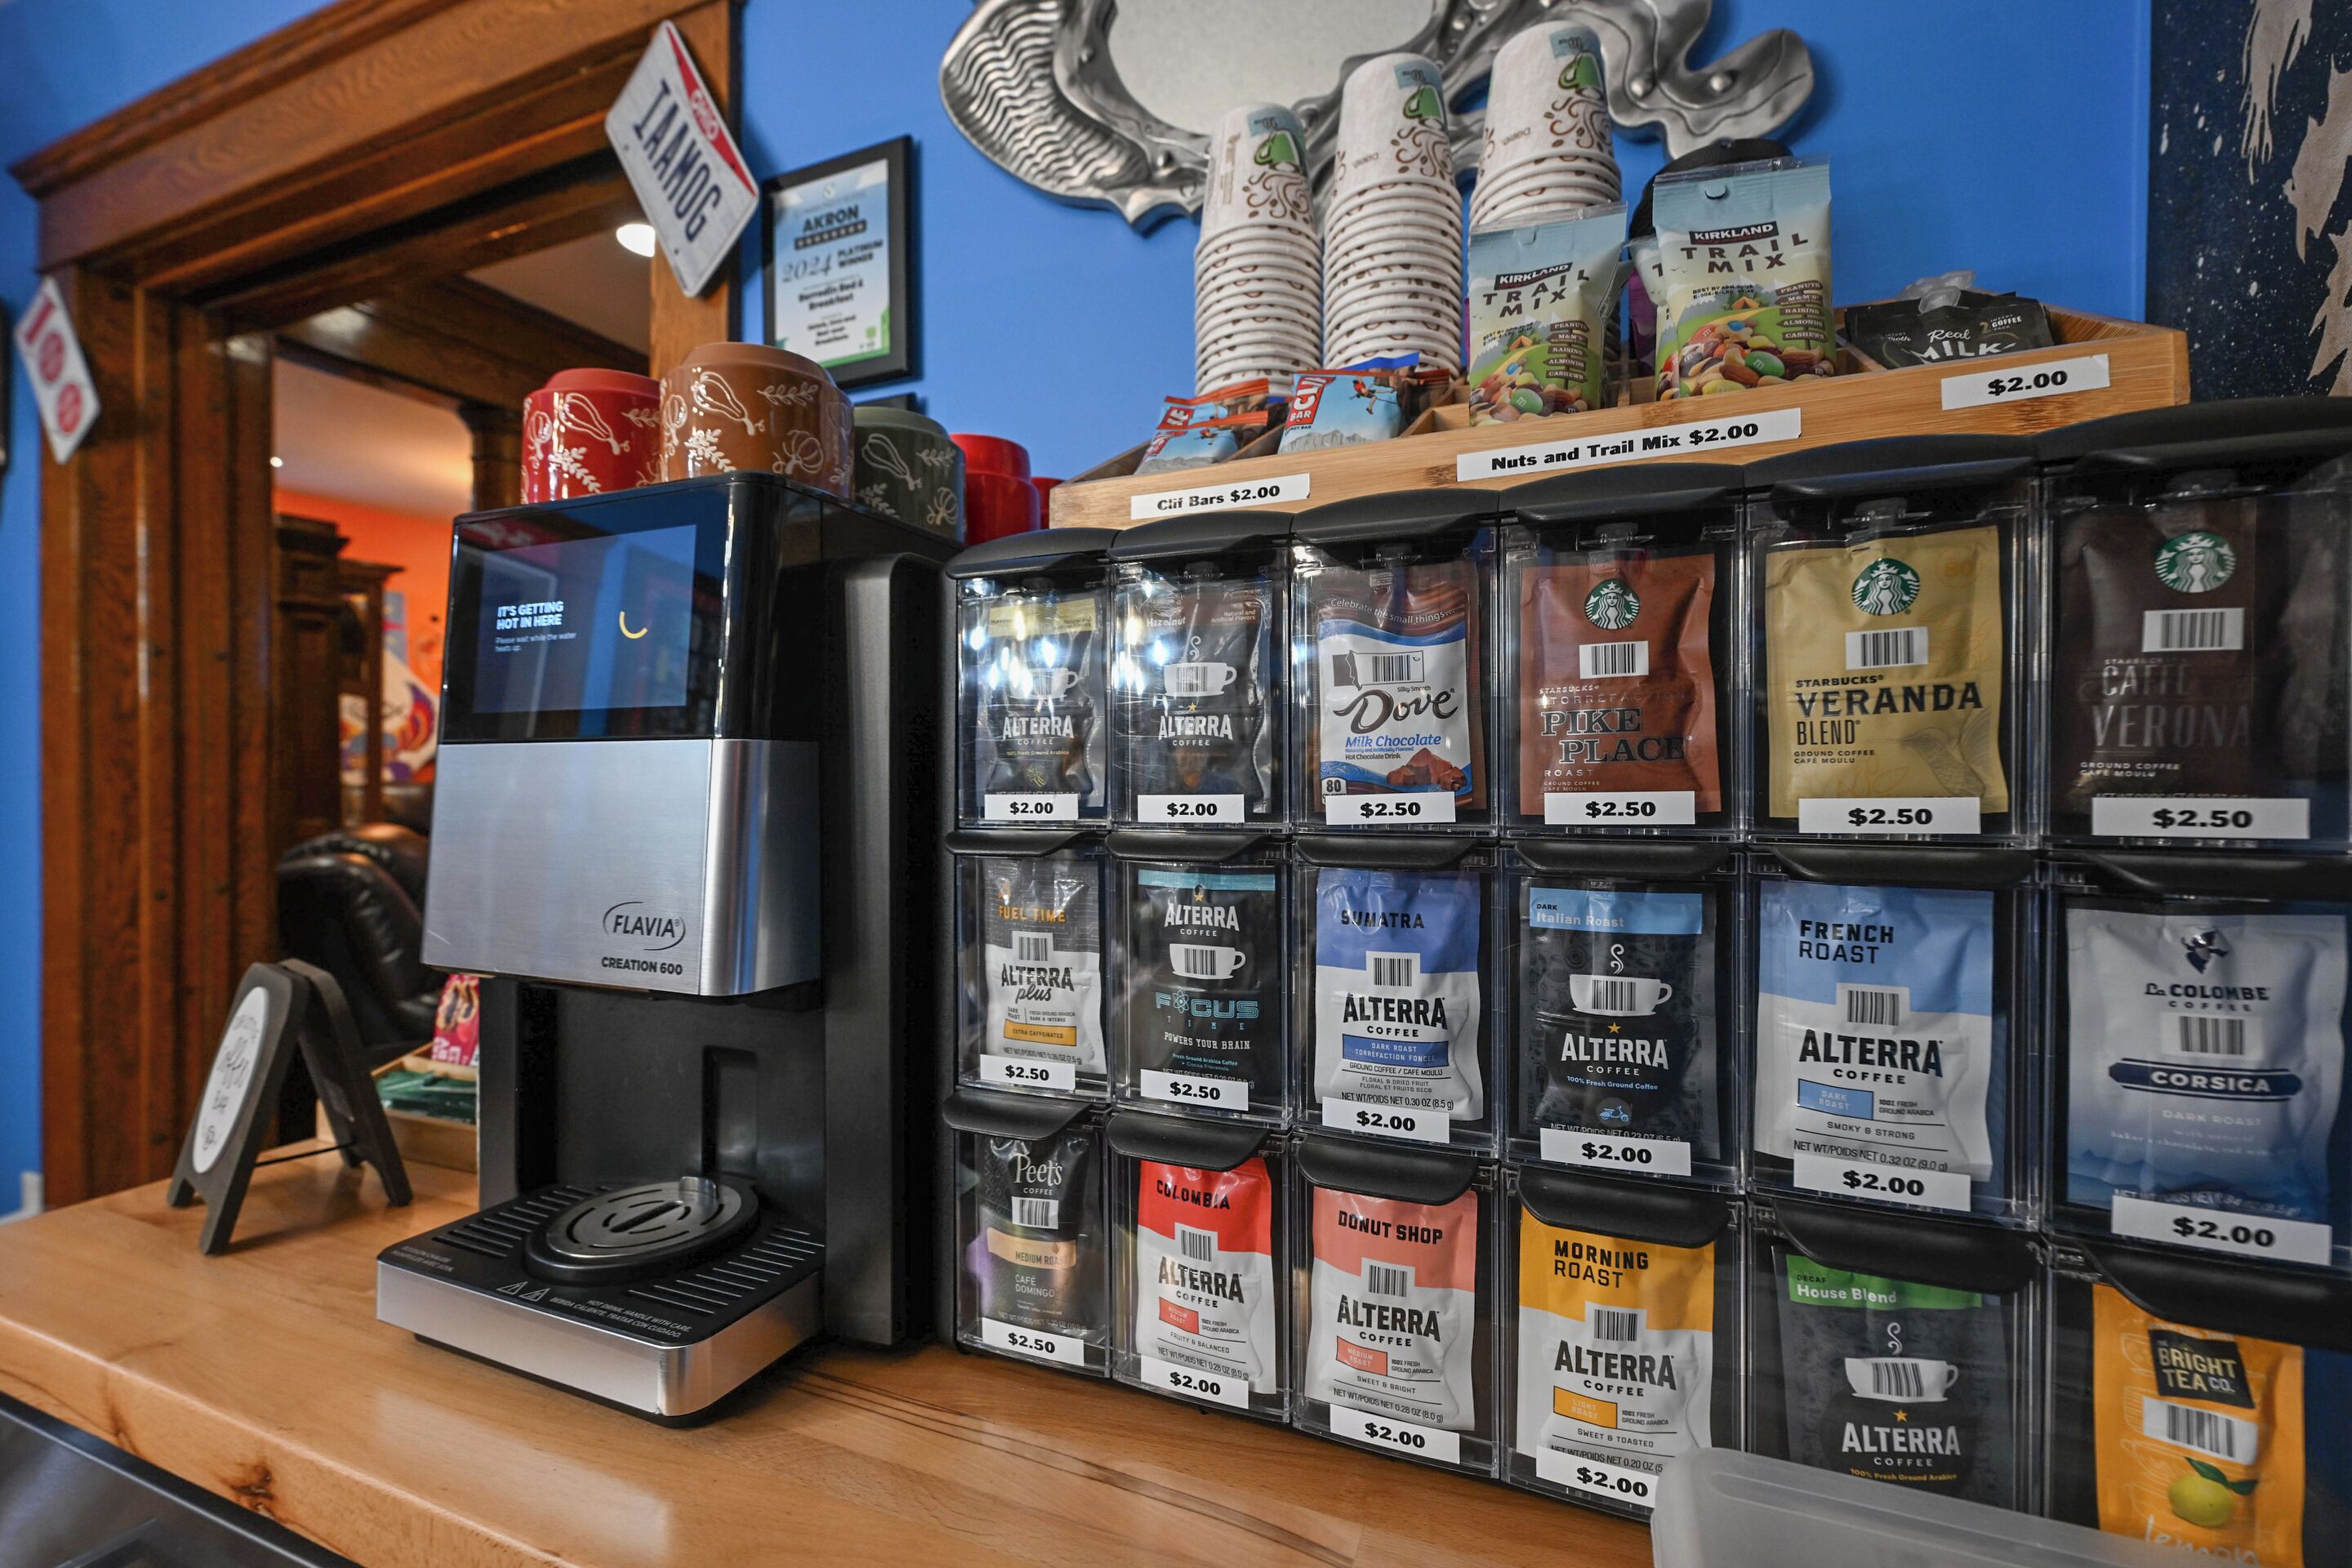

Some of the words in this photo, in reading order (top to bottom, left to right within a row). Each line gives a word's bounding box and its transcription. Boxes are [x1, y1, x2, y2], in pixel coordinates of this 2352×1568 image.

[804, 204, 858, 233] AKRON
[1695, 224, 1775, 241] KIRKLAND
[1681, 234, 1808, 260] TRAIL
[782, 254, 831, 283] 2024
[1708, 253, 1786, 273] MIX
[1499, 264, 1569, 284] KIRKLAND
[1483, 270, 1590, 305] TRAIL
[1781, 283, 1820, 293] PEANUTS
[1500, 288, 1567, 318] MIX
[1991, 315, 2022, 327] COFFEE
[1927, 329, 1971, 343] Real
[1548, 371, 1583, 380] CASHEWS
[1988, 370, 2068, 396] $2.00
[1290, 410, 1312, 421] BAR
[1491, 455, 1537, 470] Nuts
[1544, 447, 1579, 464] and
[1588, 439, 1634, 458] Trail
[1642, 434, 1681, 451] Mix
[1689, 423, 1758, 445] $2.00
[1157, 497, 1183, 511] Clif
[1189, 493, 1225, 507] Bars
[1230, 484, 1281, 502] $2.00
[497, 606, 516, 617] IT'S
[518, 601, 564, 616] GETTING
[1330, 599, 1373, 612] Celebrate
[1374, 608, 1388, 618] the
[1390, 613, 1413, 623] small
[497, 618, 519, 630] HOT
[520, 617, 532, 628] IN
[533, 613, 562, 626] HERE
[1147, 616, 1186, 627] Hazelnut
[1333, 688, 1459, 734] Dove
[1795, 682, 1983, 719] VERANDA
[1003, 715, 1074, 740] ALTERRA
[1158, 714, 1233, 741] ALTERRA
[1541, 706, 1642, 736] PIKE
[2092, 704, 2251, 748] VERONA
[1346, 737, 1374, 747] Milk
[1376, 733, 1441, 747] Chocolate
[1559, 736, 1686, 764] PLACE
[1326, 779, 1341, 793] 80
[1009, 801, 1054, 815] $2.00
[1166, 802, 1218, 817] $2.00
[1360, 802, 1421, 817] $2.50
[1586, 800, 1656, 818] $2.50
[1848, 808, 1933, 826] $2.50
[2152, 808, 2253, 829] $2.50
[999, 906, 1027, 920] FUEL
[1032, 908, 1066, 923] TIME
[1165, 902, 1240, 931] ALTERRA
[1341, 909, 1425, 929] SUMATRA
[1536, 912, 1581, 925] Italian
[1586, 915, 1624, 928] Roast
[613, 915, 675, 938] FLAVIA
[1180, 929, 1217, 937] COFFEE
[1800, 920, 1895, 943] FRENCH
[1799, 941, 1879, 964] ROAST
[602, 956, 657, 973] CREATION
[660, 962, 683, 975] 600
[1001, 963, 1075, 992] ALTERRA
[1015, 982, 1052, 1004] plus
[2145, 982, 2166, 996] La
[2171, 983, 2270, 1001] COLOMBE
[1343, 993, 1448, 1030] ALTERRA
[1029, 1030, 1063, 1039] CAFFEINATED
[1164, 1031, 1193, 1046] POWERS
[1196, 1038, 1218, 1049] YOUR
[1222, 1040, 1250, 1049] BRAIN
[1366, 1026, 1419, 1037] COFFEE
[1371, 1042, 1390, 1050] DARK
[1393, 1044, 1417, 1053] ROAST
[1561, 1032, 1669, 1070] ALTERRA
[1799, 1029, 1944, 1078] ALTERRA
[1005, 1065, 1049, 1081] $2.50
[1350, 1062, 1373, 1071] GROUND
[1374, 1065, 1396, 1074] COFFEE
[1587, 1065, 1640, 1076] COFFEE
[1833, 1068, 1906, 1085] COFFEE
[1169, 1081, 1221, 1100] $2.50
[2151, 1071, 2271, 1094] CORSICA
[1356, 1110, 1415, 1131] $2.00
[1827, 1121, 1861, 1134] SMOKY
[1876, 1128, 1915, 1140] STRONG
[1581, 1142, 1652, 1164] $2.00
[1014, 1153, 1062, 1186] Peet's
[1023, 1187, 1053, 1196] COFFEE
[1842, 1169, 1924, 1196] $2.00
[1156, 1179, 1231, 1210] COLOMBIA
[1338, 1210, 1392, 1237] DONUT
[1396, 1224, 1443, 1245] SHOP
[2172, 1216, 2275, 1248] $2.00
[1554, 1240, 1649, 1270] MORNING
[1015, 1274, 1036, 1285] CAFÉ
[1159, 1256, 1245, 1303] ALTERRA
[1554, 1259, 1624, 1289] ROAST
[1797, 1274, 1827, 1283] DECAF
[1015, 1284, 1055, 1298] DOMINGO
[1176, 1290, 1218, 1308] COFFEE
[1797, 1284, 1847, 1300] House
[1851, 1288, 1897, 1304] Blend
[652, 1317, 671, 1327] WITH
[1337, 1294, 1441, 1343] ALTERRA
[1008, 1332, 1055, 1353] $2.50
[1359, 1331, 1412, 1347] COFFEE
[1553, 1339, 1677, 1391] ALTERRA
[2157, 1346, 2237, 1379] BRIGHT
[1169, 1371, 1221, 1396] $2.00
[1584, 1379, 1644, 1397] COFFEE
[2162, 1368, 2207, 1392] TEA
[1365, 1422, 1426, 1449] $2.00
[1841, 1421, 1961, 1455] ALTERRA
[1873, 1457, 1933, 1467] COFFEE
[1576, 1467, 1649, 1498] $2.00
